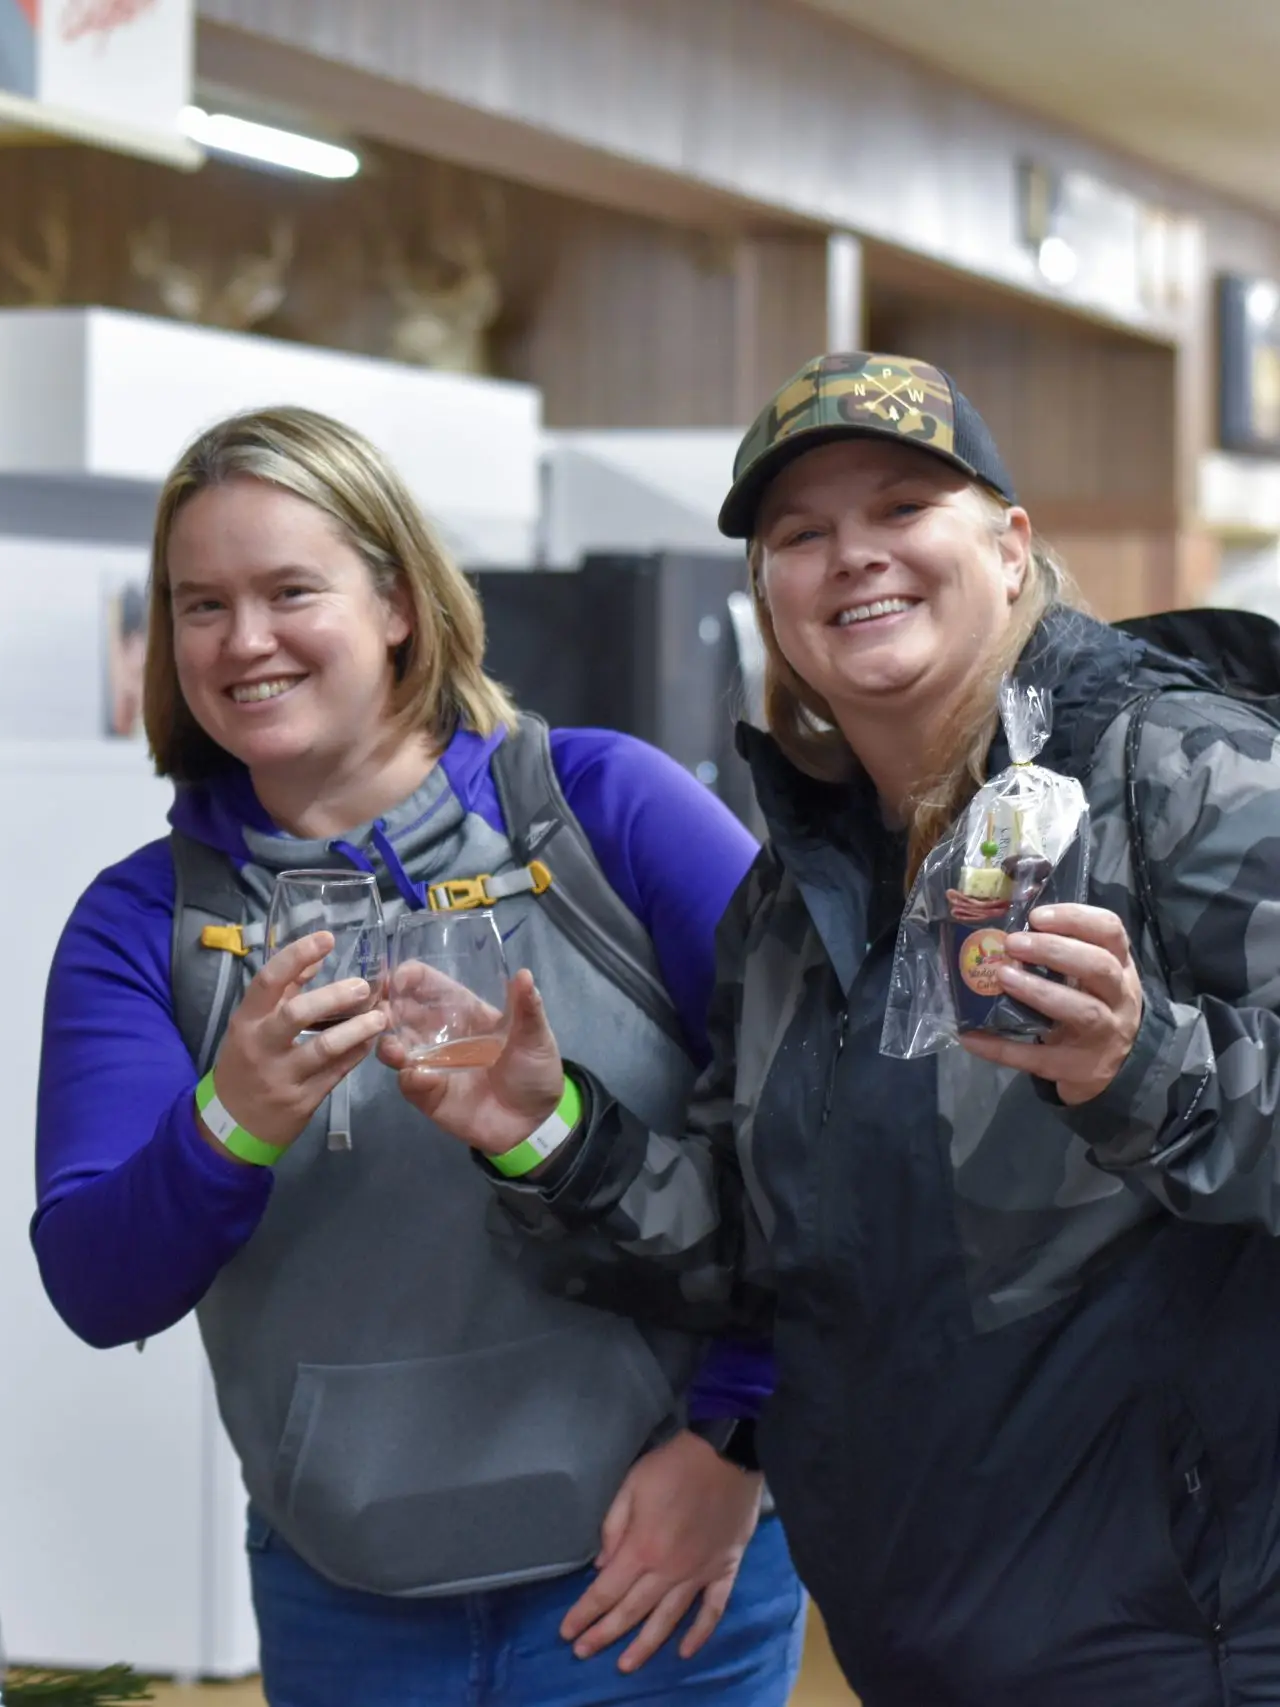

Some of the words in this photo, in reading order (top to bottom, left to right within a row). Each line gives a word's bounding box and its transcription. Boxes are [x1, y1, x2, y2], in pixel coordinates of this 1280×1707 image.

[882, 367, 893, 380] P
[854, 383, 866, 397] N
[907, 387, 925, 404] W
